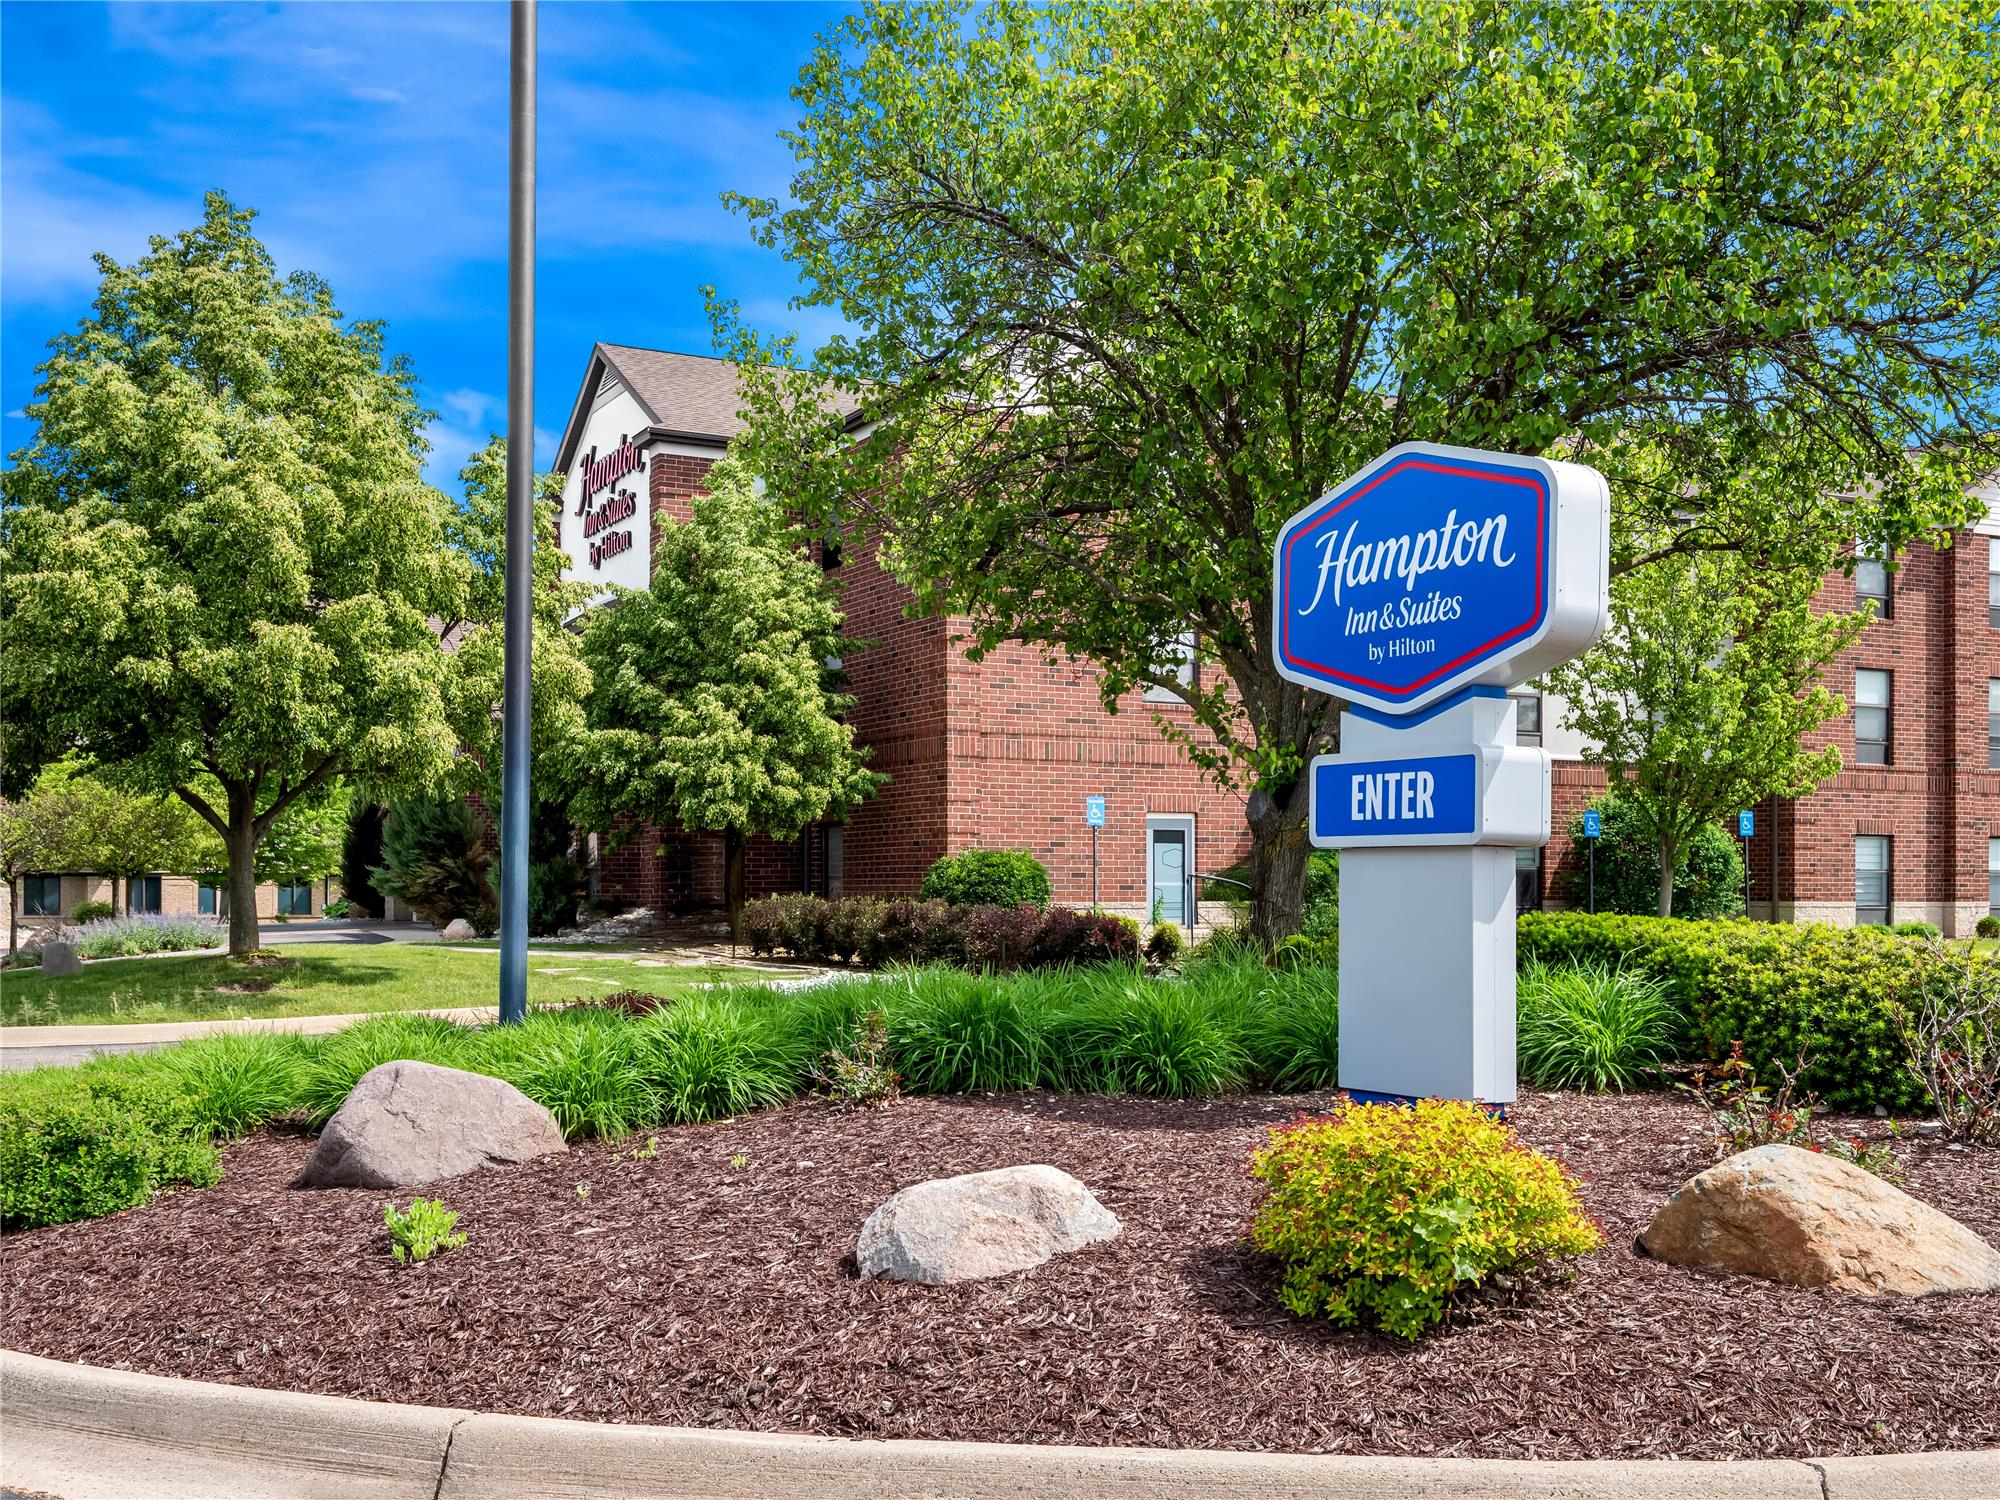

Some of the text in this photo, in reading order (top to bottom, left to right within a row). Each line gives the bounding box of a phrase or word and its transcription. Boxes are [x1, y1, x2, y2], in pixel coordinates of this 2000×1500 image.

[575, 434, 646, 517] Hampton
[589, 531, 632, 570] by Hilton
[1298, 509, 1516, 615] Hampton
[1369, 638, 1435, 664] by Hilton
[1351, 770, 1435, 821] ENTER
